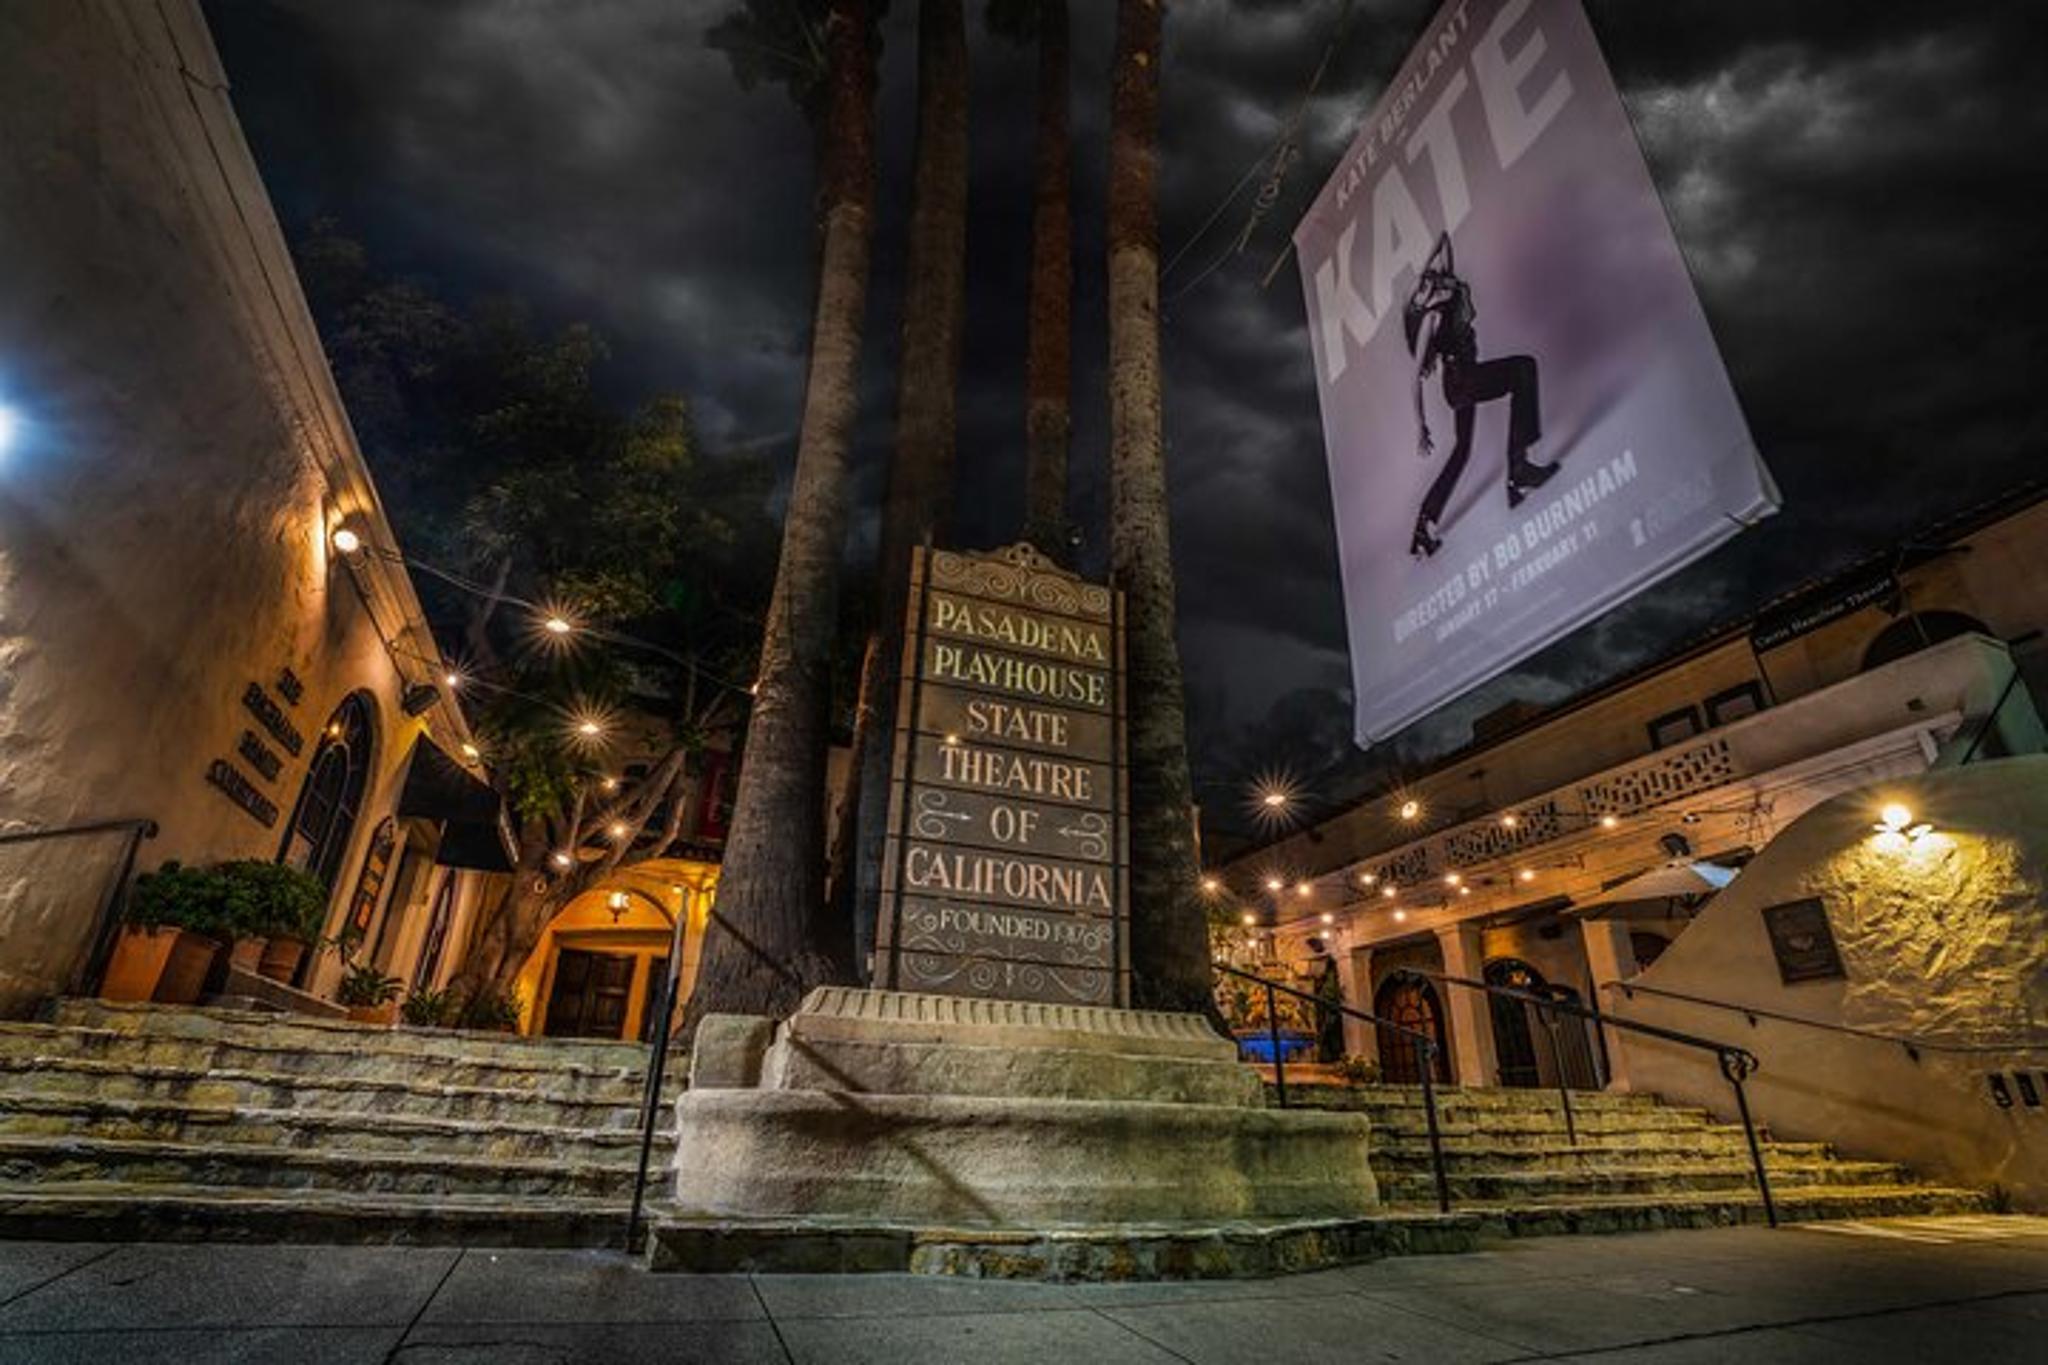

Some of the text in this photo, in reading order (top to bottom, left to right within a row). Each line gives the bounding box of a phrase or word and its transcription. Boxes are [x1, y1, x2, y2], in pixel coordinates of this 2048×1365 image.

[1315, 0, 1576, 384] KATE
[1467, 552, 1490, 589] BY
[1493, 532, 1523, 570] BO
[1522, 449, 1638, 549] BURNHAM
[933, 599, 1105, 661] PASADENA
[933, 645, 1105, 706] PLAYHOUSE
[967, 702, 1068, 747] STATE
[938, 743, 1092, 802] THEATRE
[989, 805, 1039, 844] OF
[905, 847, 1111, 909] CALIFORNIA
[940, 908, 1050, 942] FOUNDED
